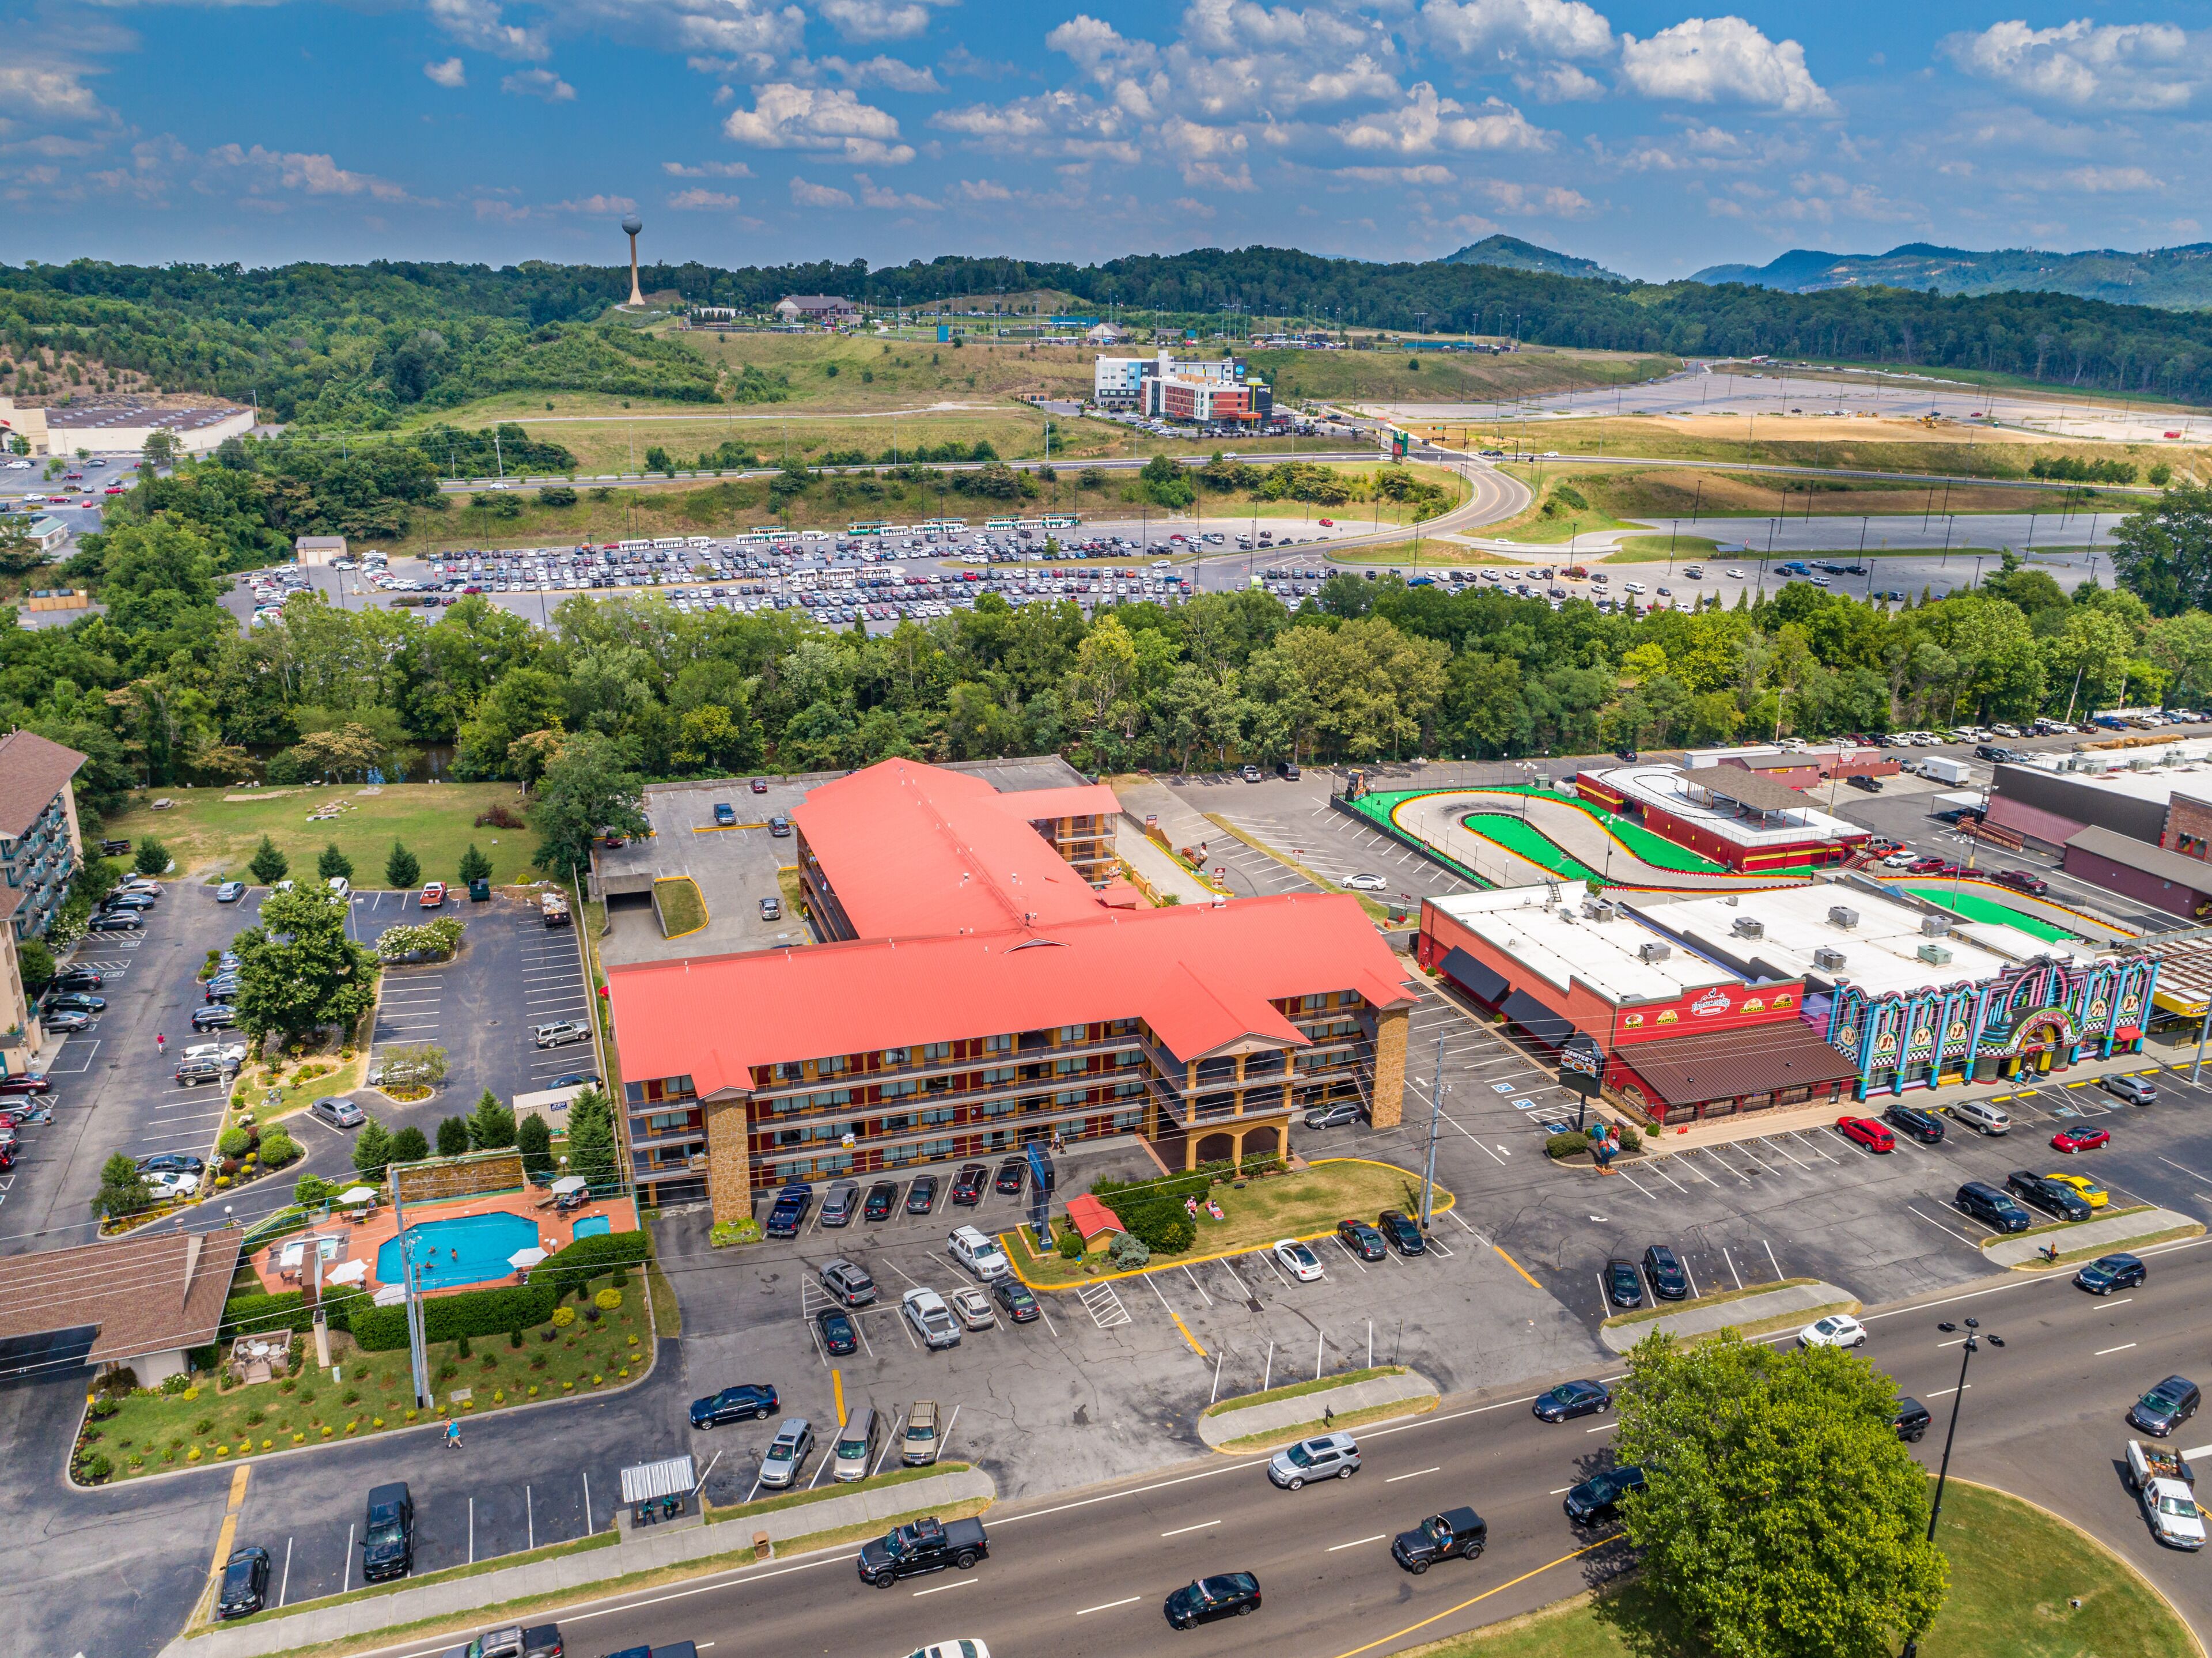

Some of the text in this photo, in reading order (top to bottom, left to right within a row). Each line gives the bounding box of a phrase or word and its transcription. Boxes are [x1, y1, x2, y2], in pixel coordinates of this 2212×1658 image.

[1692, 999, 1730, 1011] FARMHOUSE
[2018, 1011, 2069, 1036] ARCADE
[1565, 1049, 1596, 1065] SAWYER'S
